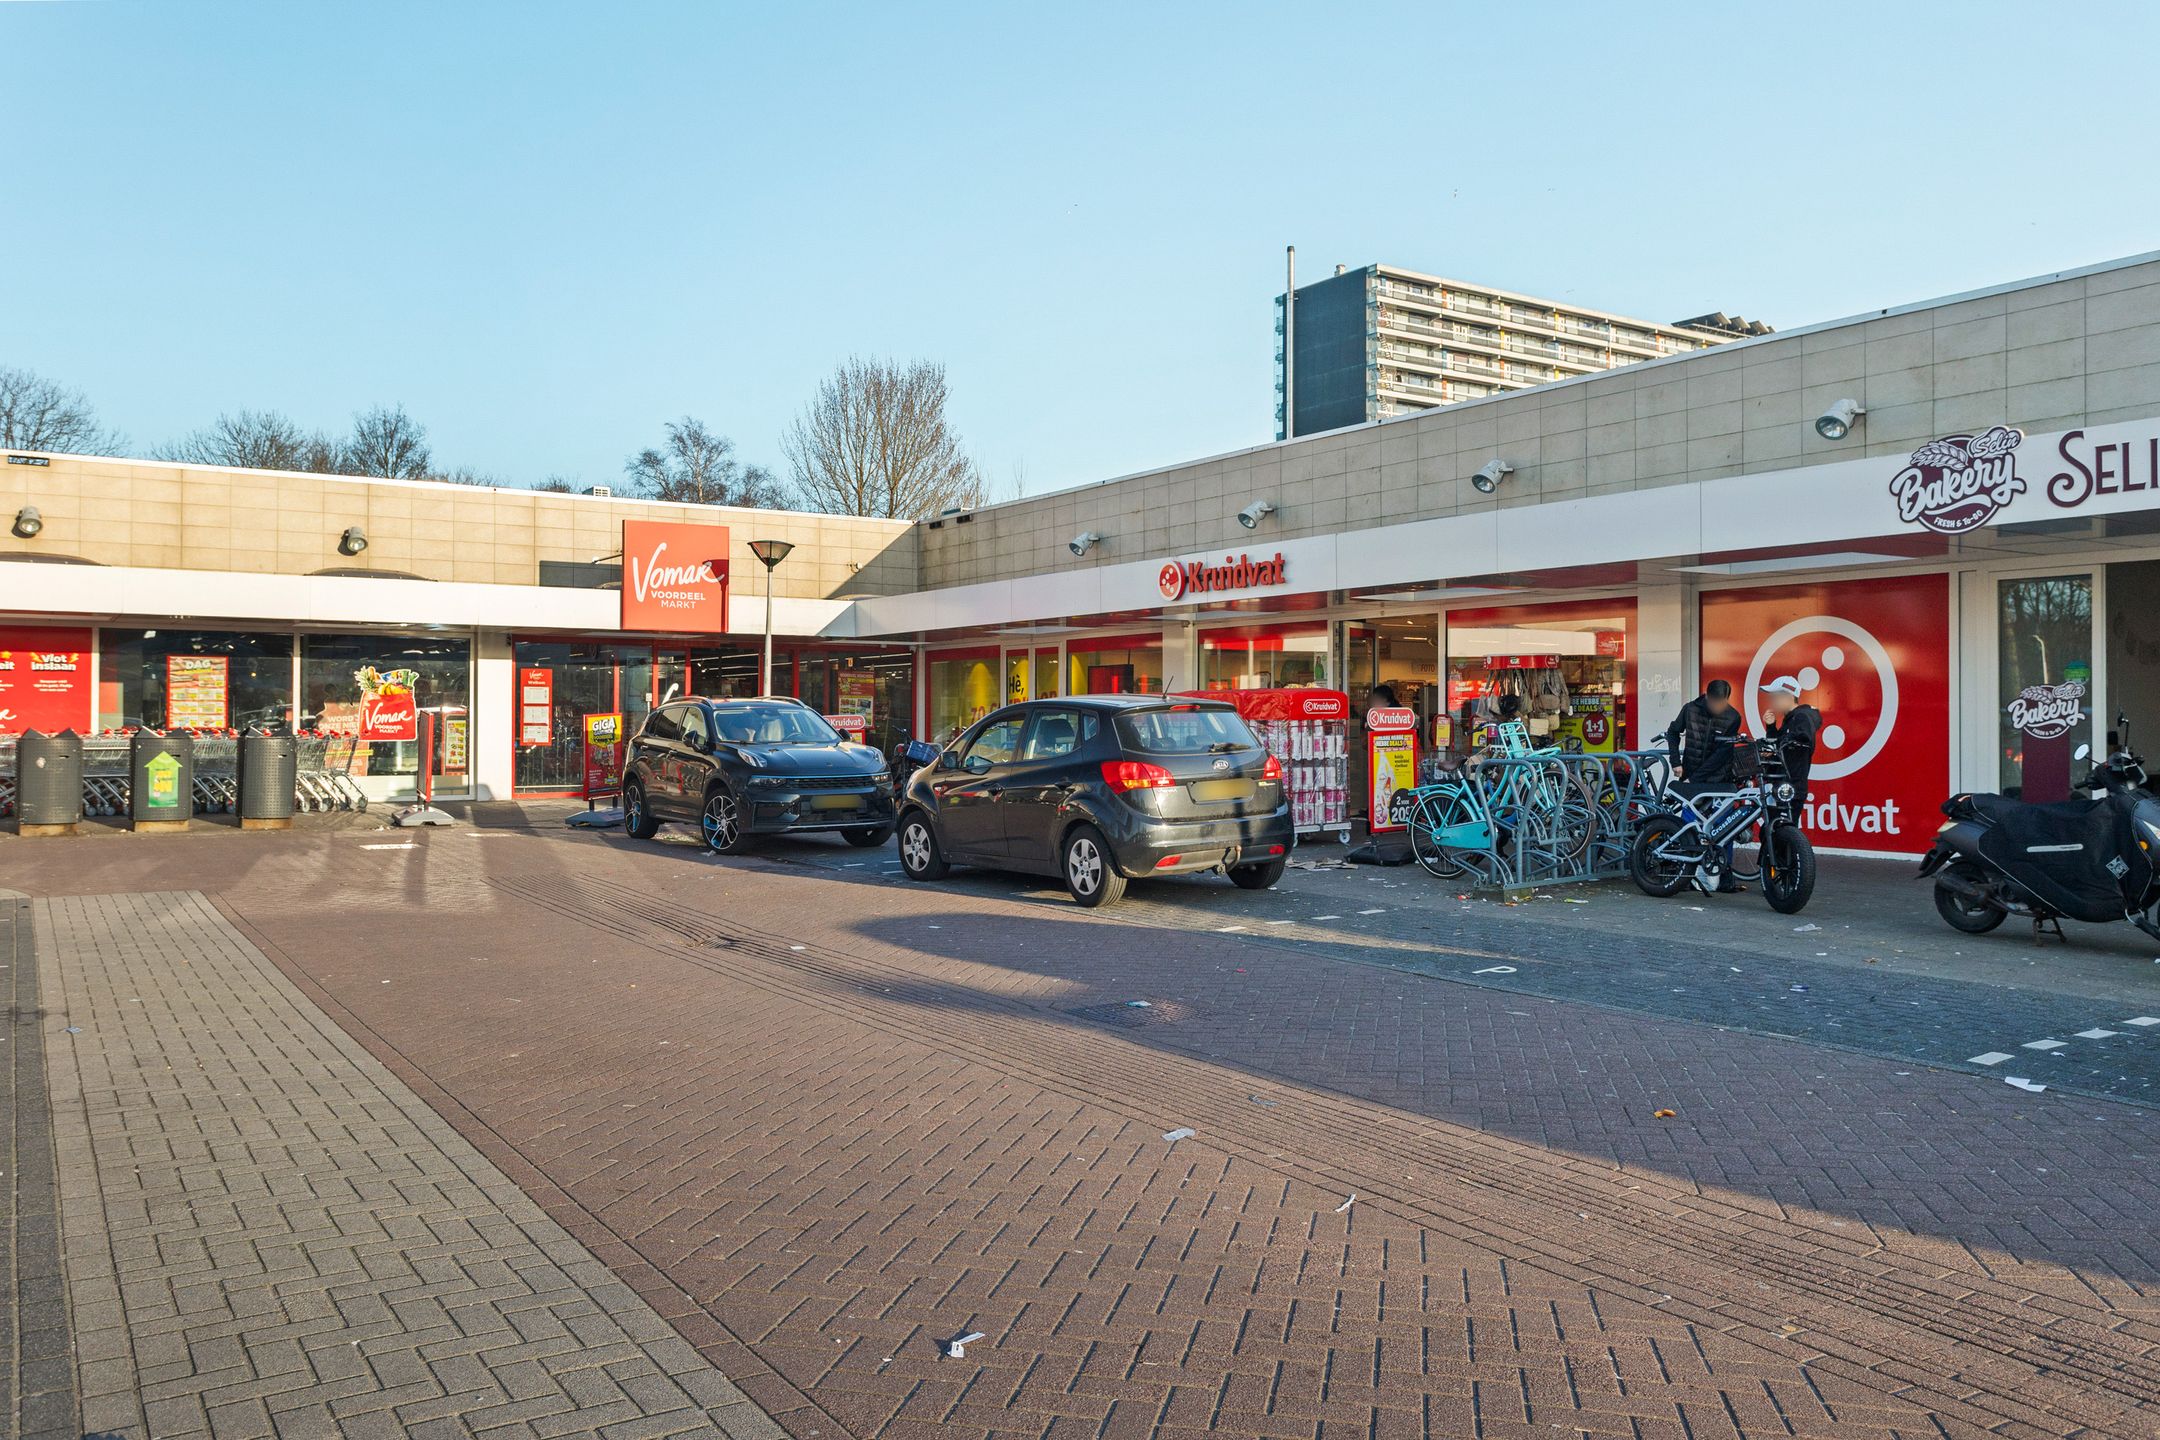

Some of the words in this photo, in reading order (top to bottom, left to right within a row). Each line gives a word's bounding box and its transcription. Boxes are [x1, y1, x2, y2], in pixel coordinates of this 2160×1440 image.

[1974, 431, 2018, 457] Selin
[1891, 455, 2026, 520] Bakery
[1933, 516, 1956, 528] FRESH
[1956, 519, 1962, 527] &
[632, 542, 725, 603] Vomar
[1188, 552, 1286, 593] Kruidvat
[651, 590, 706, 601] VOORDEEL
[661, 600, 696, 609] MARKT
[41, 654, 67, 663] Vlot
[185, 660, 211, 669] DAG
[1420, 663, 1436, 671] FOTO
[1008, 674, 1024, 694] Hè,
[1312, 702, 1338, 711] Kruidvat
[2007, 698, 2086, 729] Bakery
[327, 715, 354, 723] WORD
[365, 702, 413, 731] Vomar
[830, 718, 862, 727] Kruidvat
[1379, 711, 1411, 725] Kruidvat
[592, 717, 616, 731] GIGA
[1586, 719, 1605, 733] 1+1
[1396, 796, 1402, 806] 2
[1798, 792, 1901, 835] idvat
[1710, 809, 1743, 838] CrossBoss
